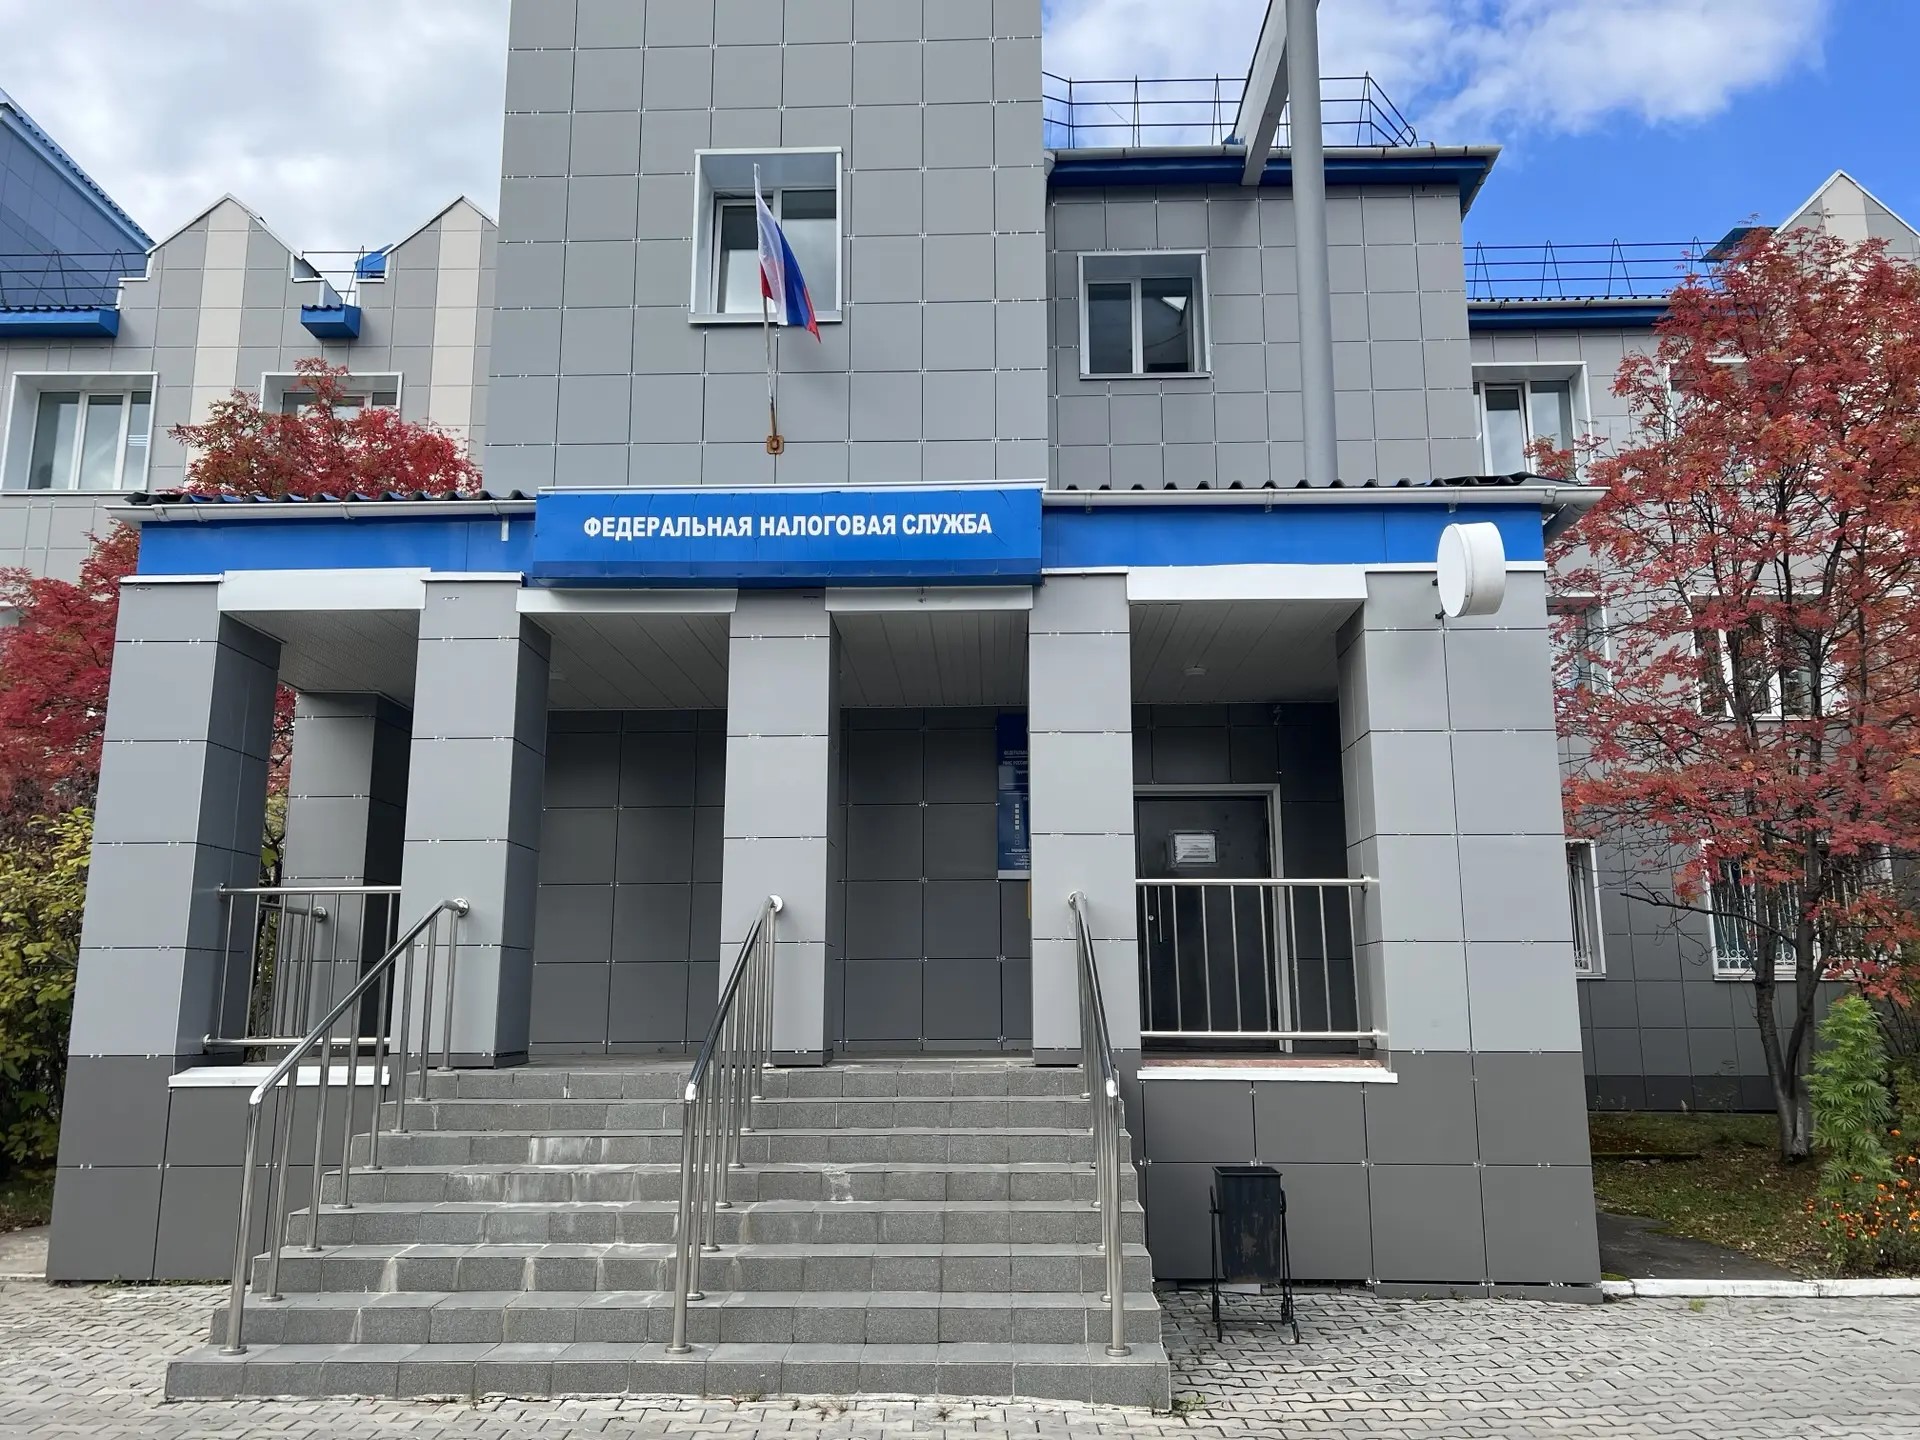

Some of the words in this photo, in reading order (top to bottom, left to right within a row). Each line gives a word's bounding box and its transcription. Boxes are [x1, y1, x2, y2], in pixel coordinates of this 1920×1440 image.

[583, 516, 752, 541] ФЕДЕРАЛЬНАЯ
[760, 514, 896, 536] НАЛОГОВАЯ
[902, 513, 993, 535] СЛУЖБА
